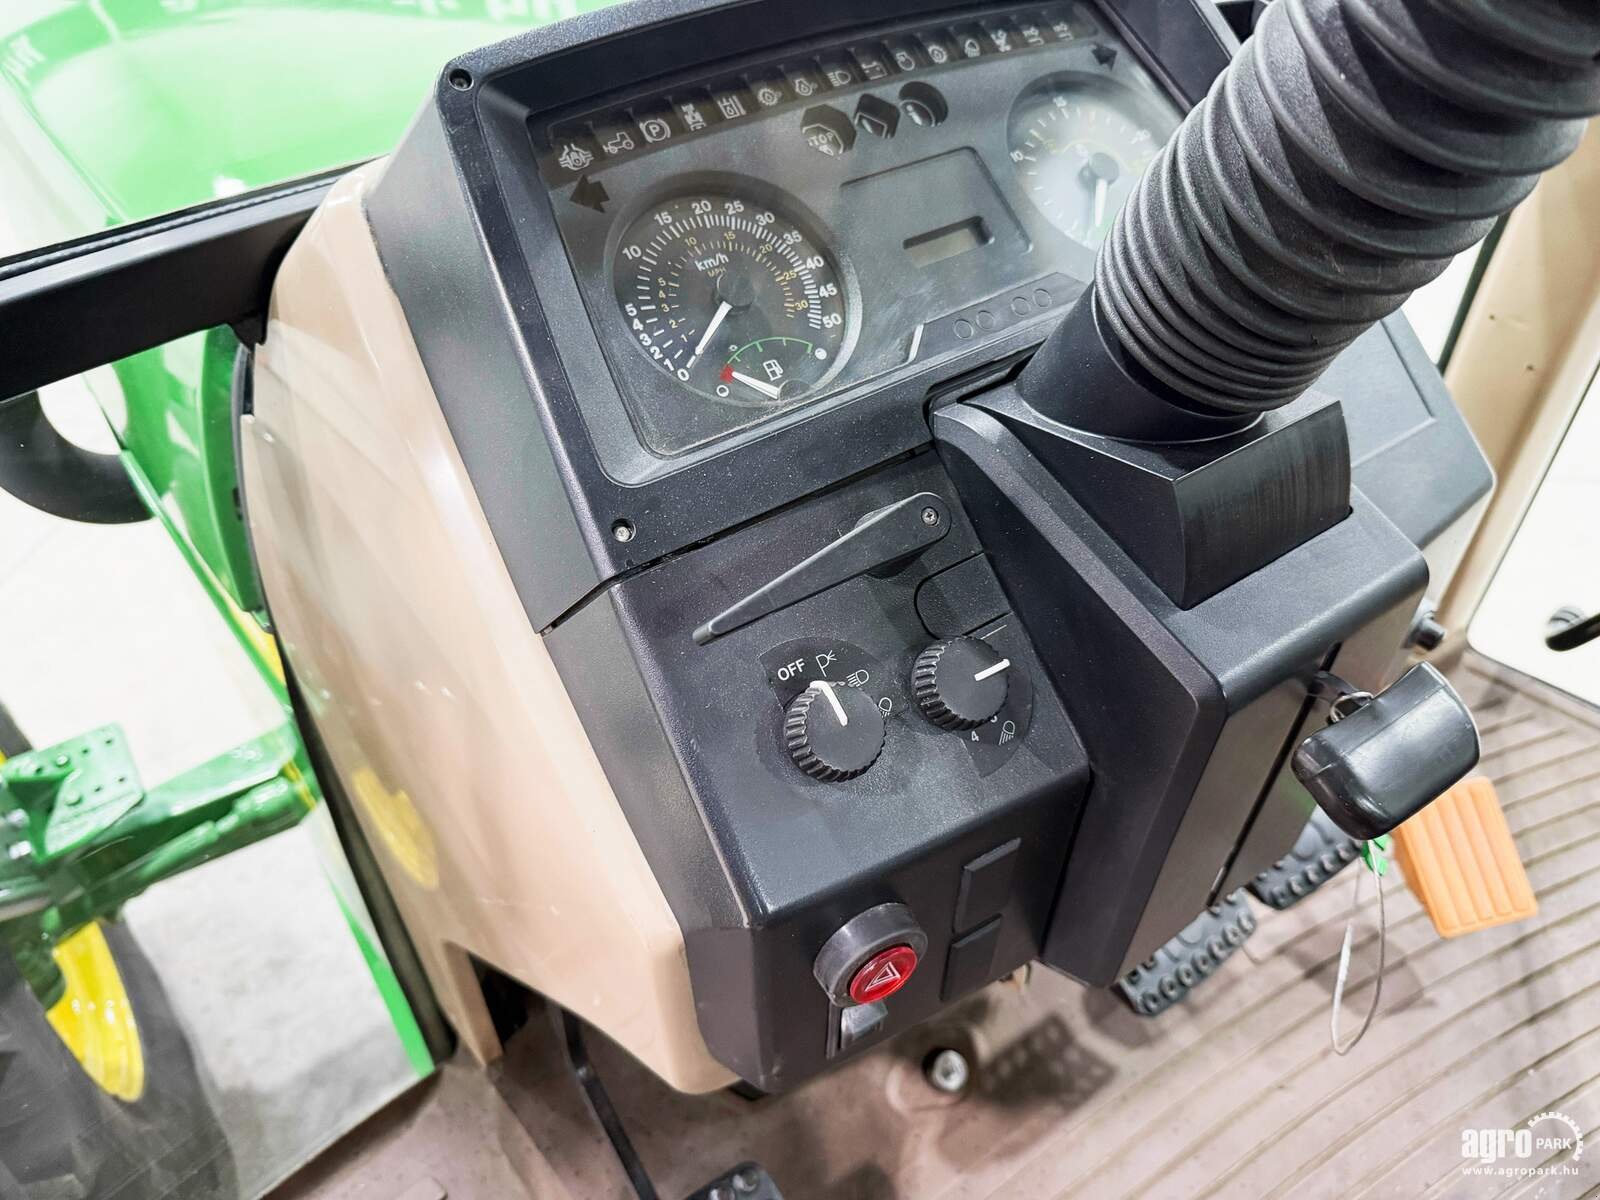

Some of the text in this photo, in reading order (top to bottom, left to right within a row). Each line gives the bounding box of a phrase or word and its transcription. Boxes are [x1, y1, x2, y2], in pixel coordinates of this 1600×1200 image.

[1010, 150, 1023, 162] 10
[692, 200, 712, 215] 20
[724, 201, 745, 215] 25
[654, 211, 673, 226] 15
[755, 212, 775, 226] 30
[685, 237, 697, 247] 10
[724, 231, 736, 240] 15
[783, 231, 802, 245] 35
[622, 245, 642, 260] 10
[759, 244, 773, 254] 20
[695, 253, 729, 272] km/h
[805, 256, 824, 270] 40
[783, 271, 797, 280] 25
[658, 278, 666, 287] 5
[658, 290, 666, 299] 4
[819, 285, 838, 299] 45
[625, 303, 637, 317] 5
[661, 303, 670, 313] 3
[795, 301, 808, 310] 30
[633, 318, 644, 331] 4
[669, 320, 678, 329] 2
[823, 315, 842, 329] 50
[639, 333, 652, 346] 3
[650, 346, 663, 360] 2
[663, 358, 674, 371] 1
[677, 368, 690, 381] 0
[777, 658, 806, 681] OFF
[970, 731, 980, 742] 4
